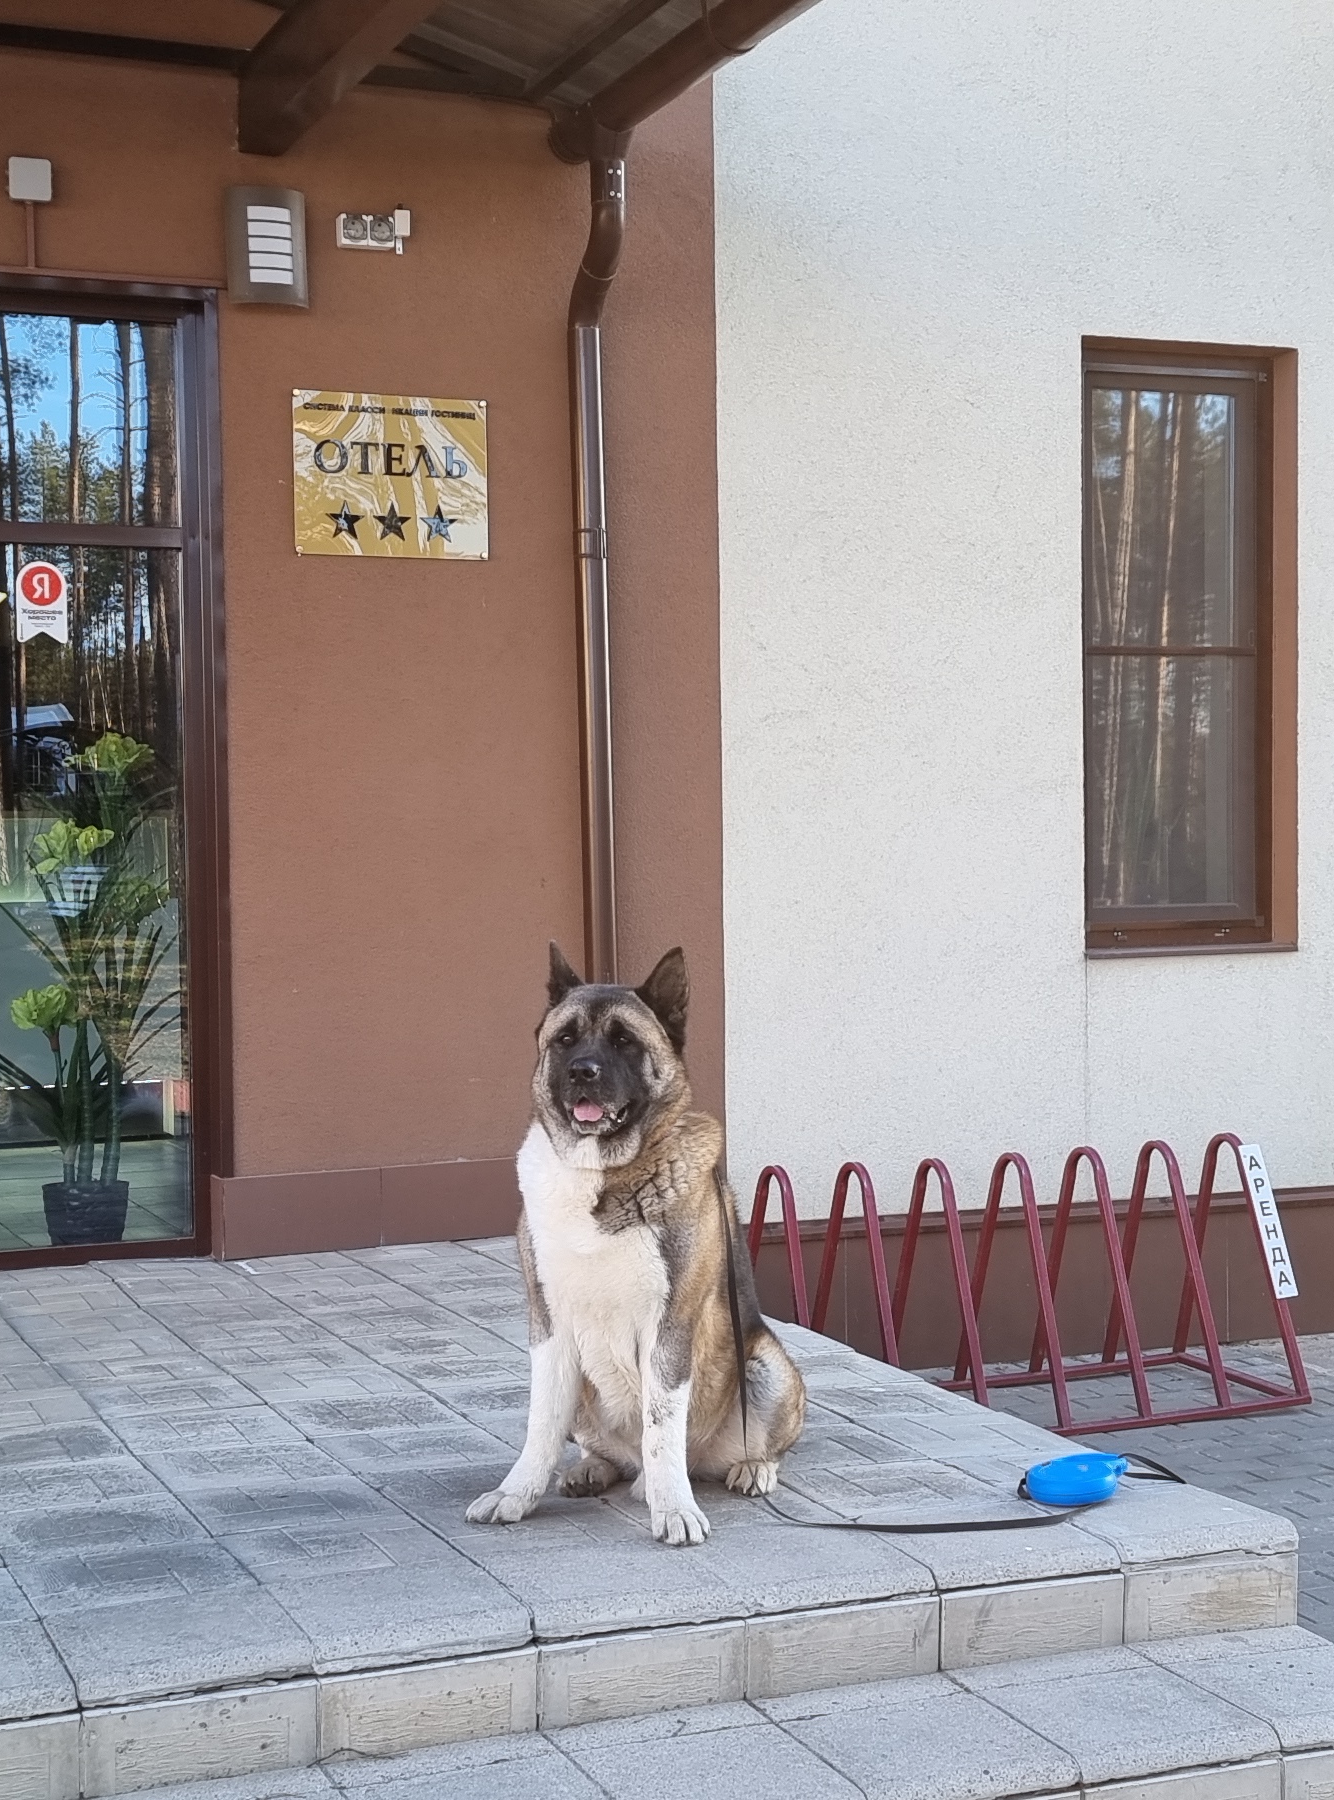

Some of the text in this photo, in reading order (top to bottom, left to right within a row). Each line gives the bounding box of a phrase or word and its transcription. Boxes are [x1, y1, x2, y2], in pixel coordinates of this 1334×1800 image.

[314, 438, 468, 479] ОТЕЛЬ
[32, 573, 50, 599] Я
[1249, 1155, 1291, 1287] АРЕНДА
